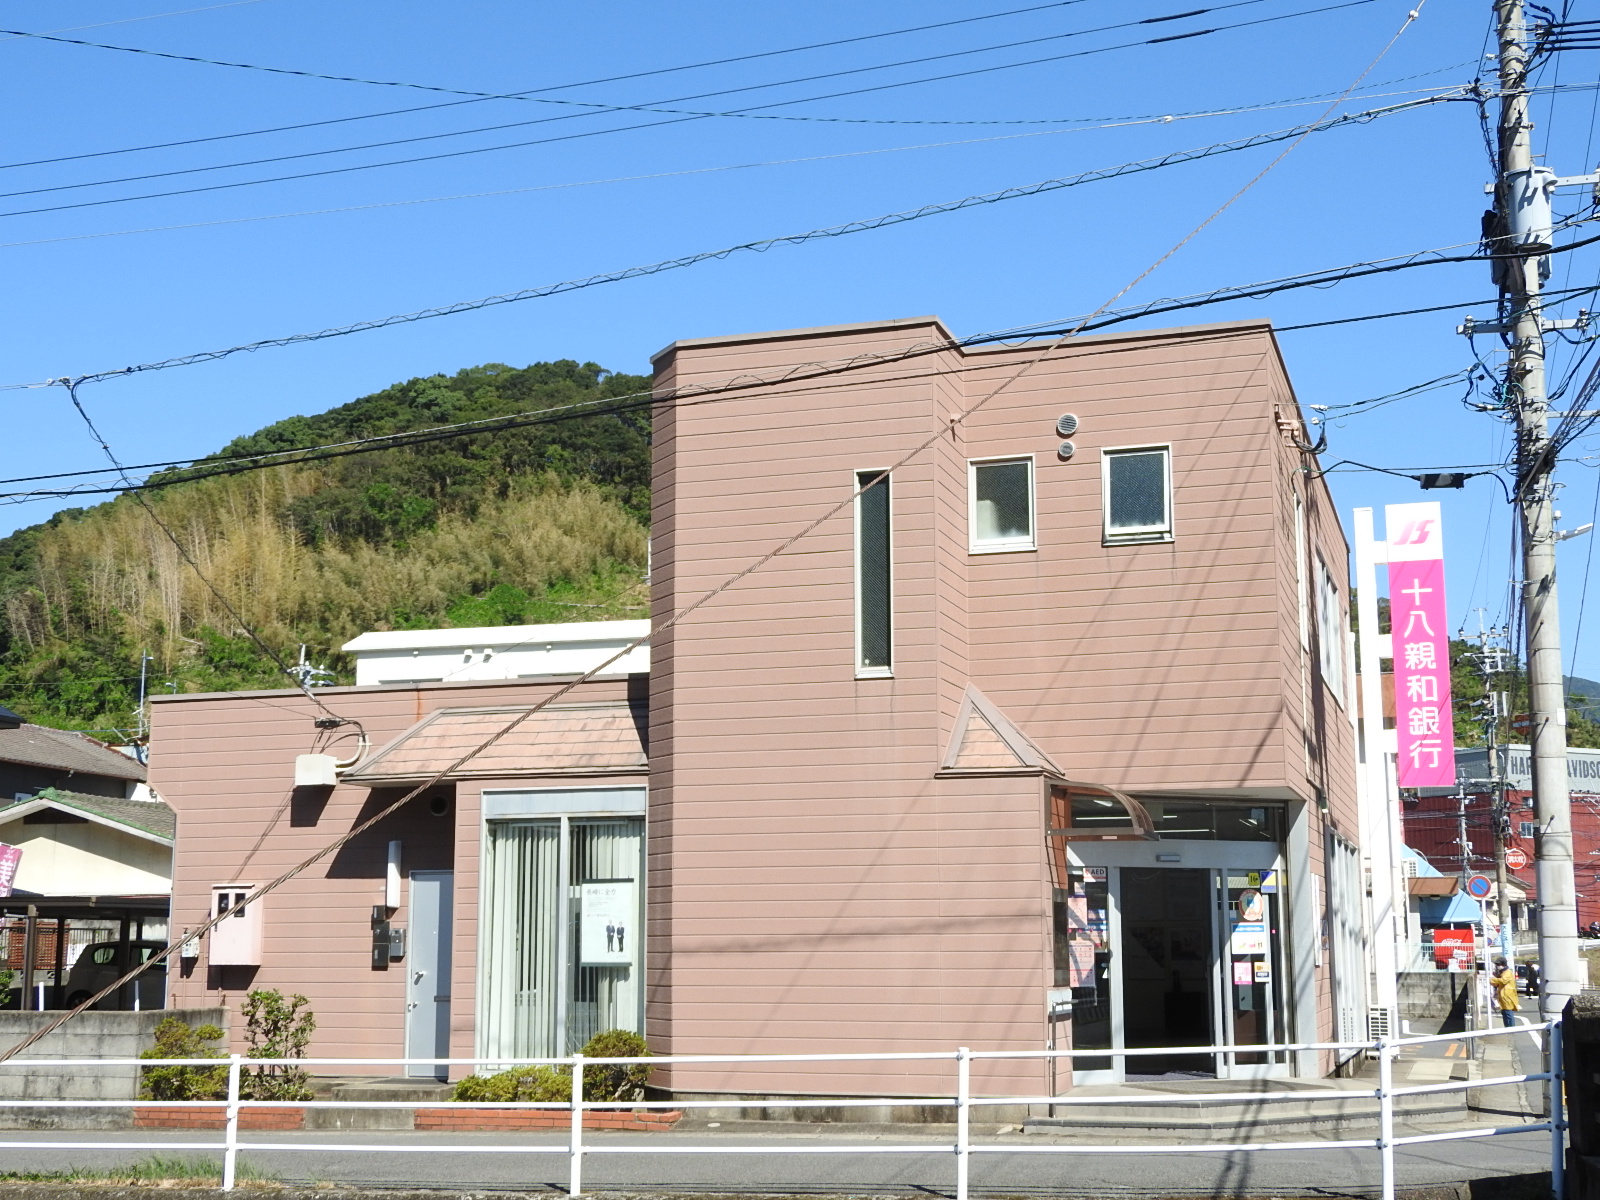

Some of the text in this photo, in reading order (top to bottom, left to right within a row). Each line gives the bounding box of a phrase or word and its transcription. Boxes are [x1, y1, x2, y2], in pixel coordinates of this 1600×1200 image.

[1401, 578, 1442, 769] 十八親和銀行
[1502, 925, 1510, 955] KUMON
